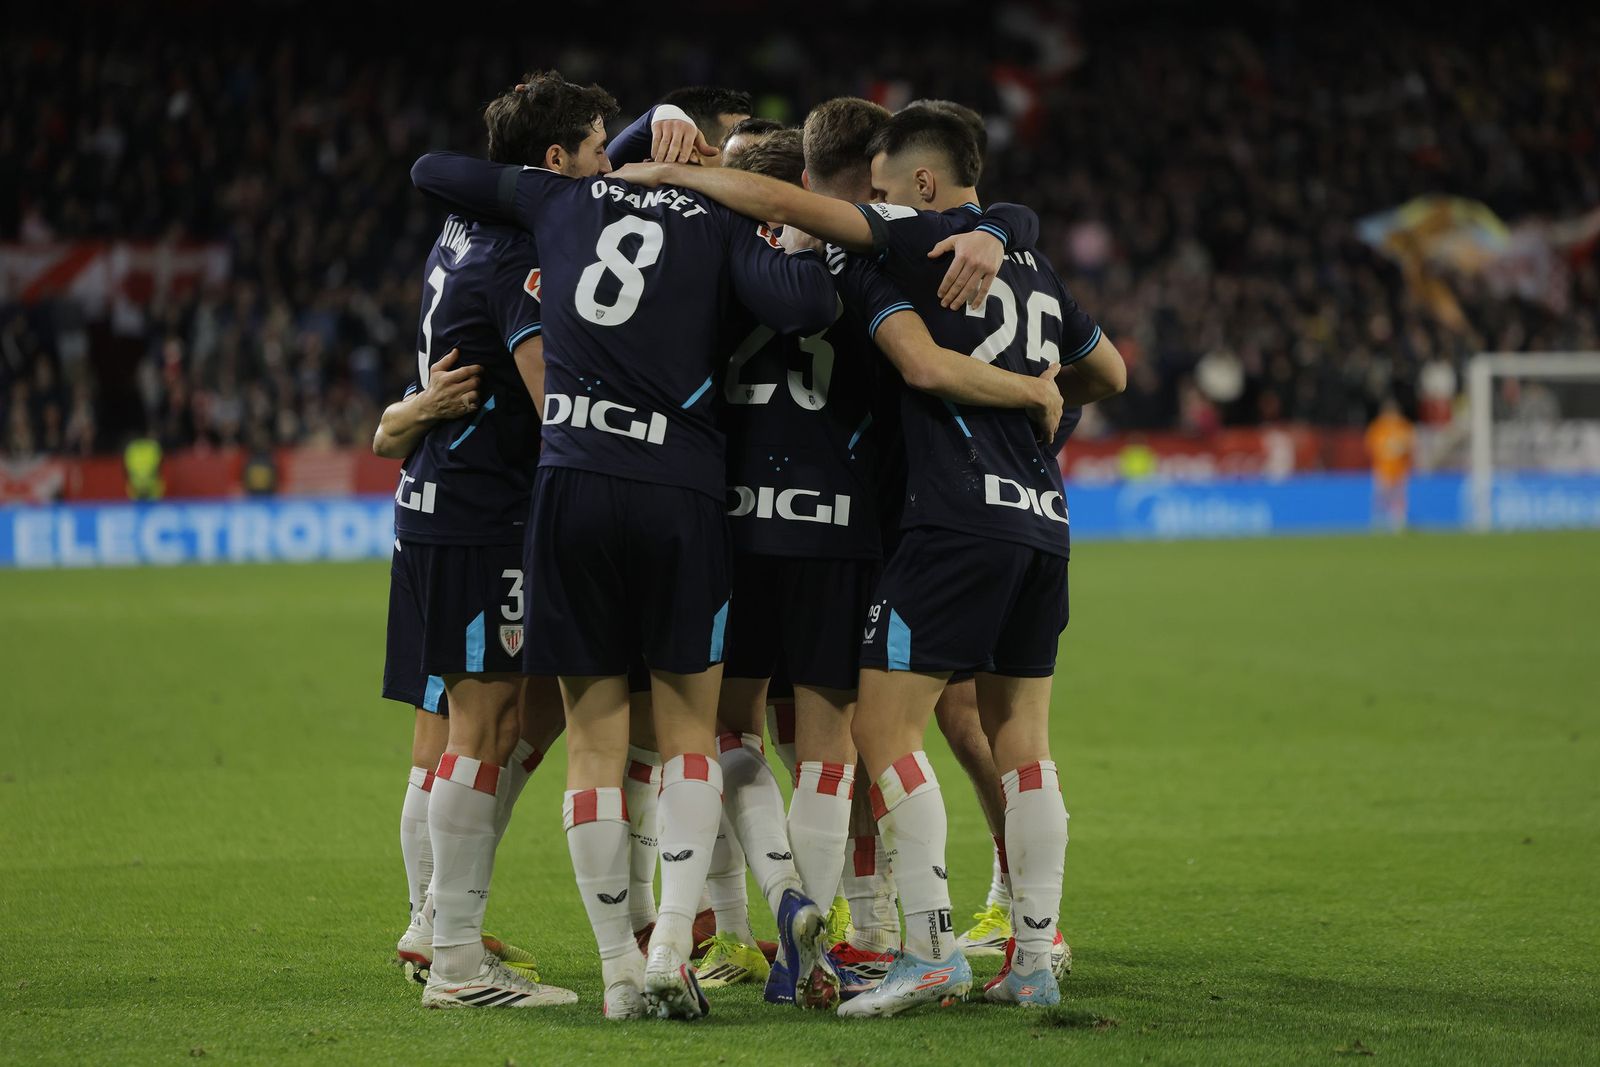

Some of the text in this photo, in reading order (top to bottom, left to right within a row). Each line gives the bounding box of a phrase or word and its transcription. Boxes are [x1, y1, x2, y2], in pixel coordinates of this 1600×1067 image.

[575, 214, 664, 327] 8
[965, 277, 1063, 364] 25
[542, 393, 669, 446] DIGI
[726, 485, 851, 527] DIGI
[984, 473, 1070, 526] DIG
[500, 568, 525, 621] 3
[928, 911, 942, 960] TAPEDESIGN
